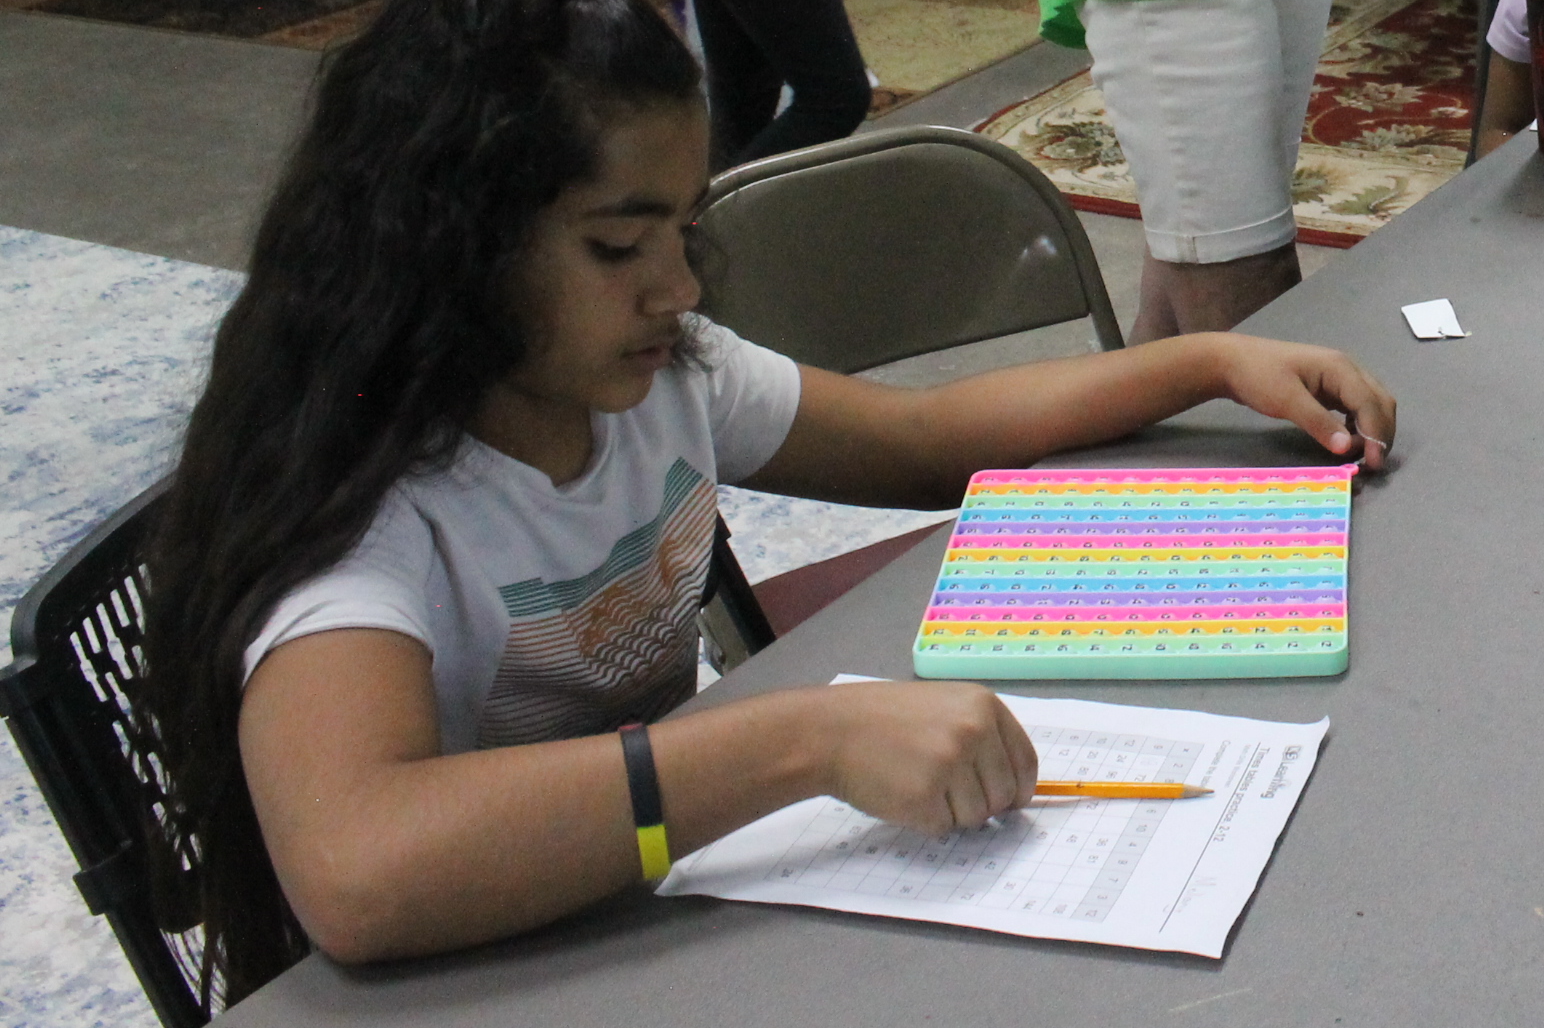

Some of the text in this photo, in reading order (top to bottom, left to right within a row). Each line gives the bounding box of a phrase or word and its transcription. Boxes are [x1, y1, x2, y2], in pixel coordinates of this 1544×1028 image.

[1251, 746, 1270, 769] Times
[1241, 767, 1258, 793] tables
[1260, 760, 1289, 799] Learning
[1213, 825, 1231, 843] 2-12
